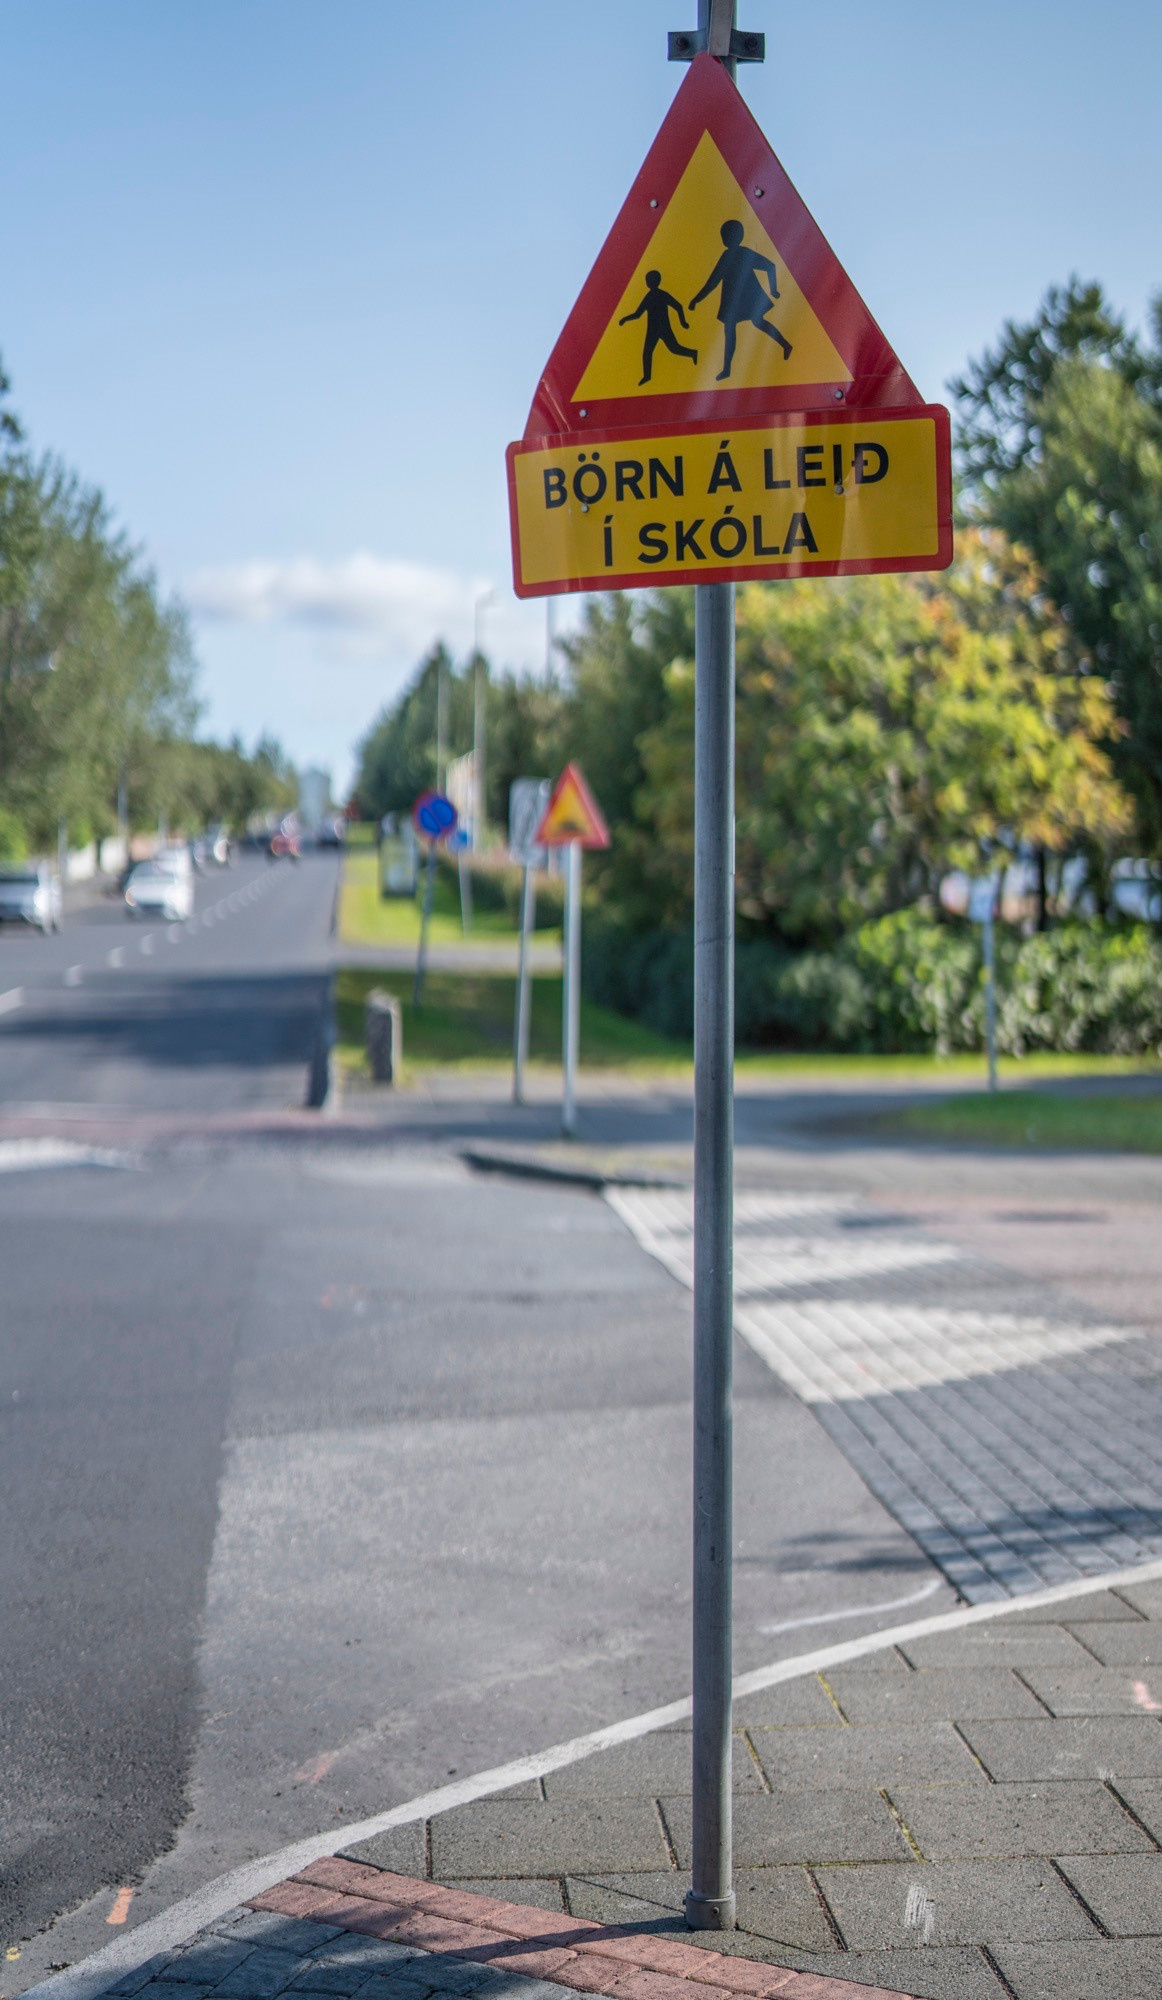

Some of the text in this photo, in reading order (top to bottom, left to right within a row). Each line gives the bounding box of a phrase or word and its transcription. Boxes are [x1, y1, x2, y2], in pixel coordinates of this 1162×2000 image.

[543, 440, 889, 509] BÖRN Á LEIÐ
[603, 505, 818, 567] Í SKÓLA
